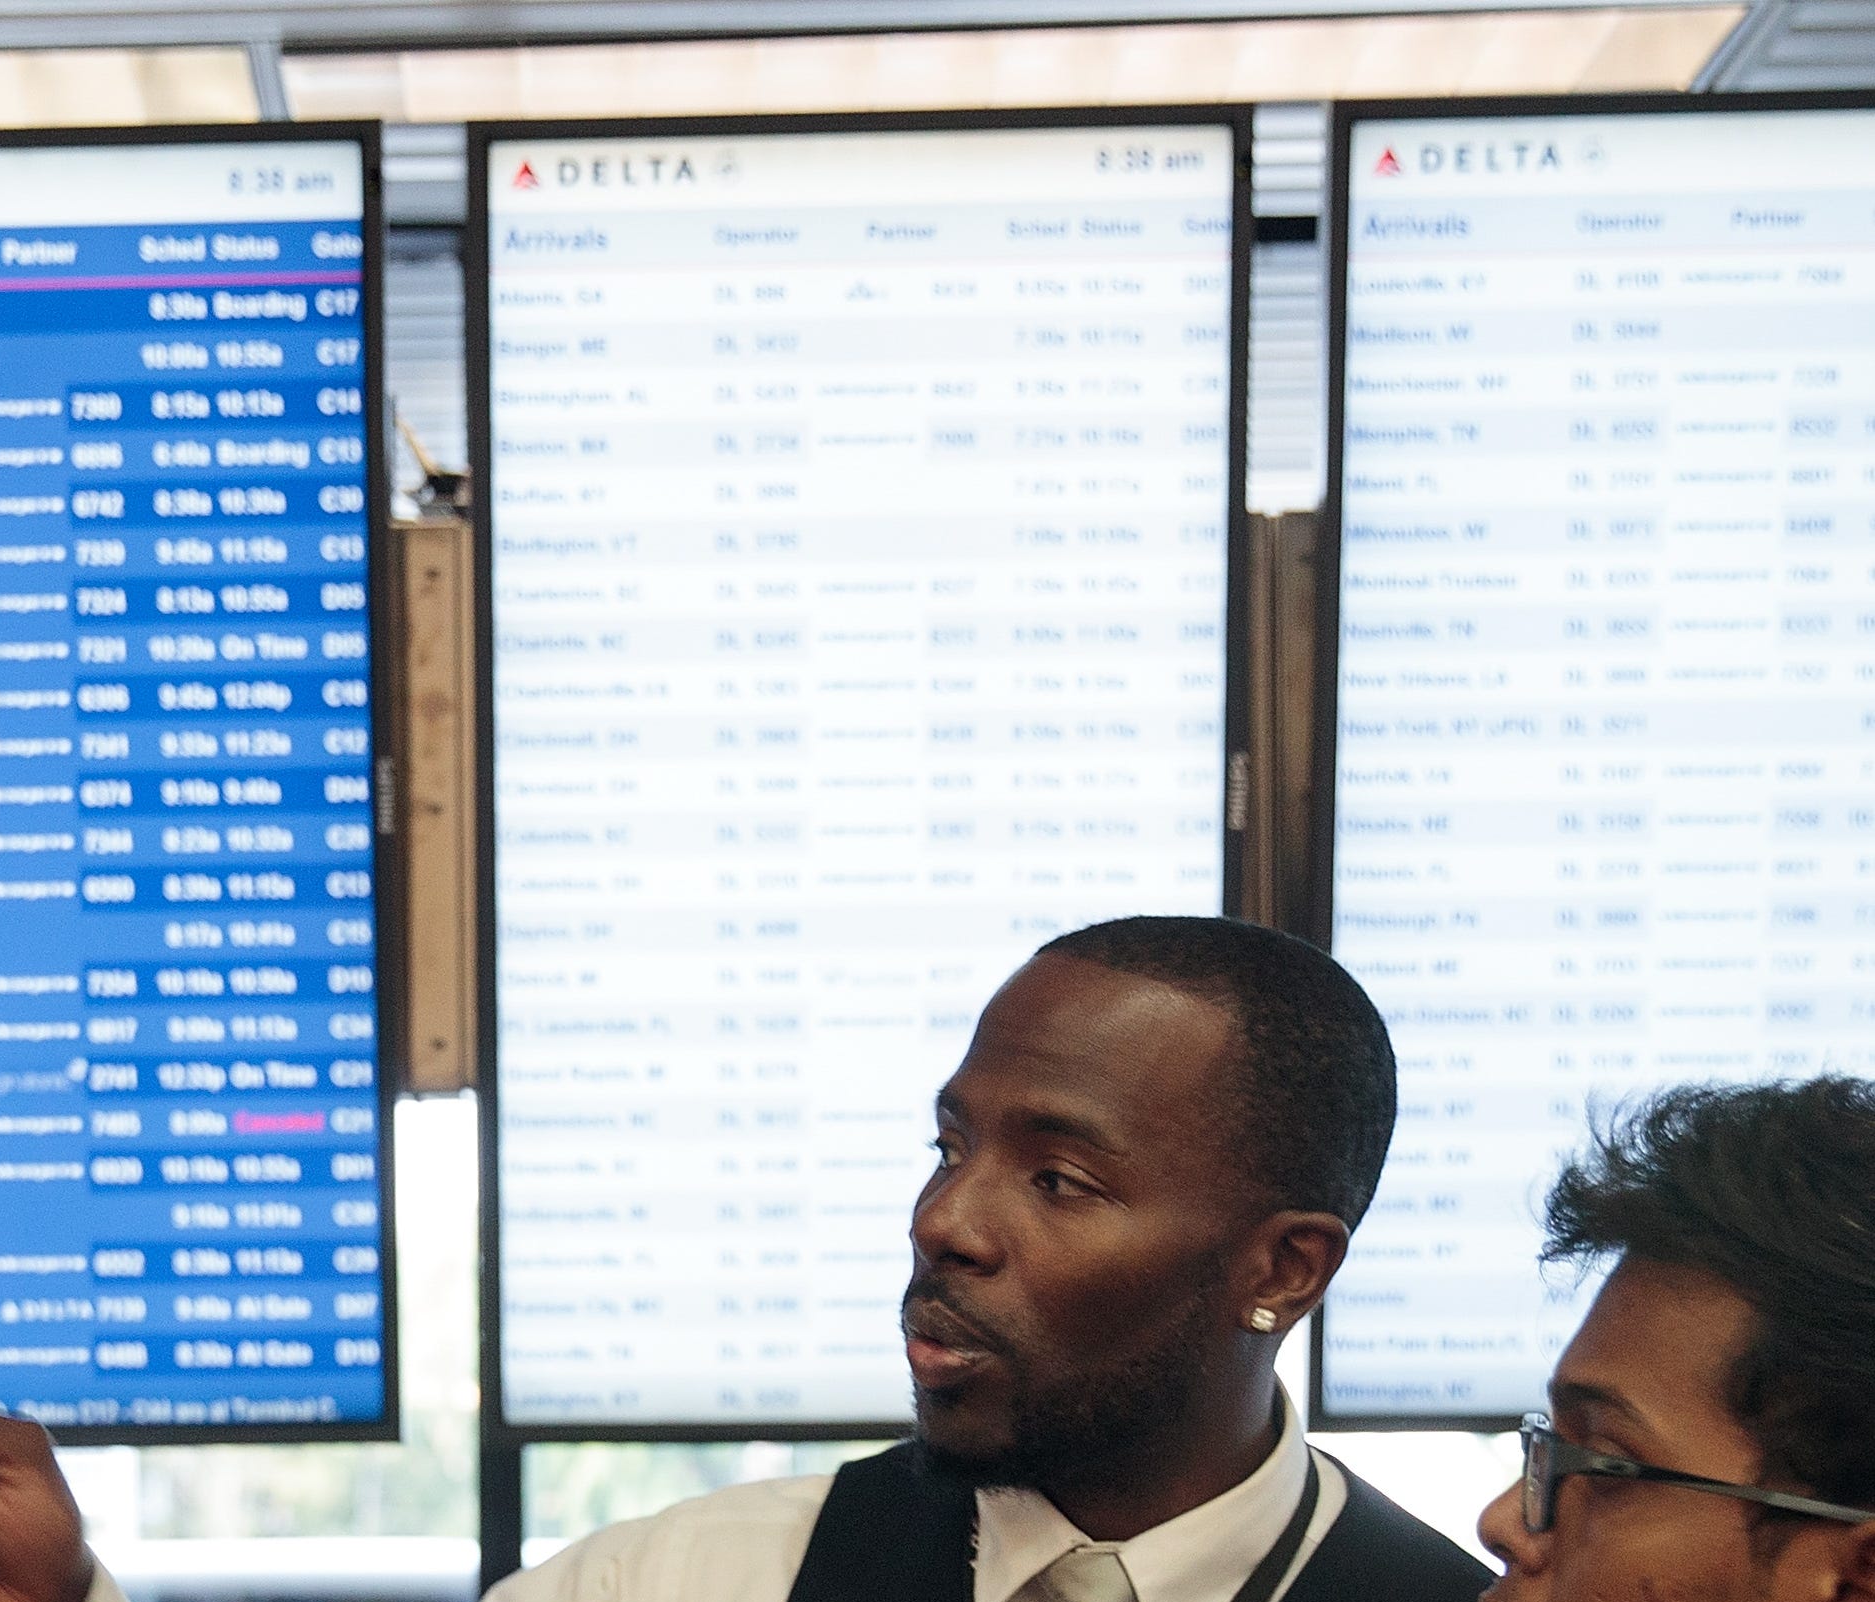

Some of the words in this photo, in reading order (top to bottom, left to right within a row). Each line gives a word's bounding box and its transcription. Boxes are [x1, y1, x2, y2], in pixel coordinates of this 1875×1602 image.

[558, 157, 696, 186] DELTA
[1419, 142, 1560, 174] DELTA
[503, 226, 609, 253] Arrivals
[1363, 212, 1470, 241] Arrivals
[1, 239, 77, 266] Partner
[139, 236, 207, 263] Sched
[212, 234, 280, 262] Status
[311, 232, 364, 260] Gate
[212, 292, 307, 321] Boarding
